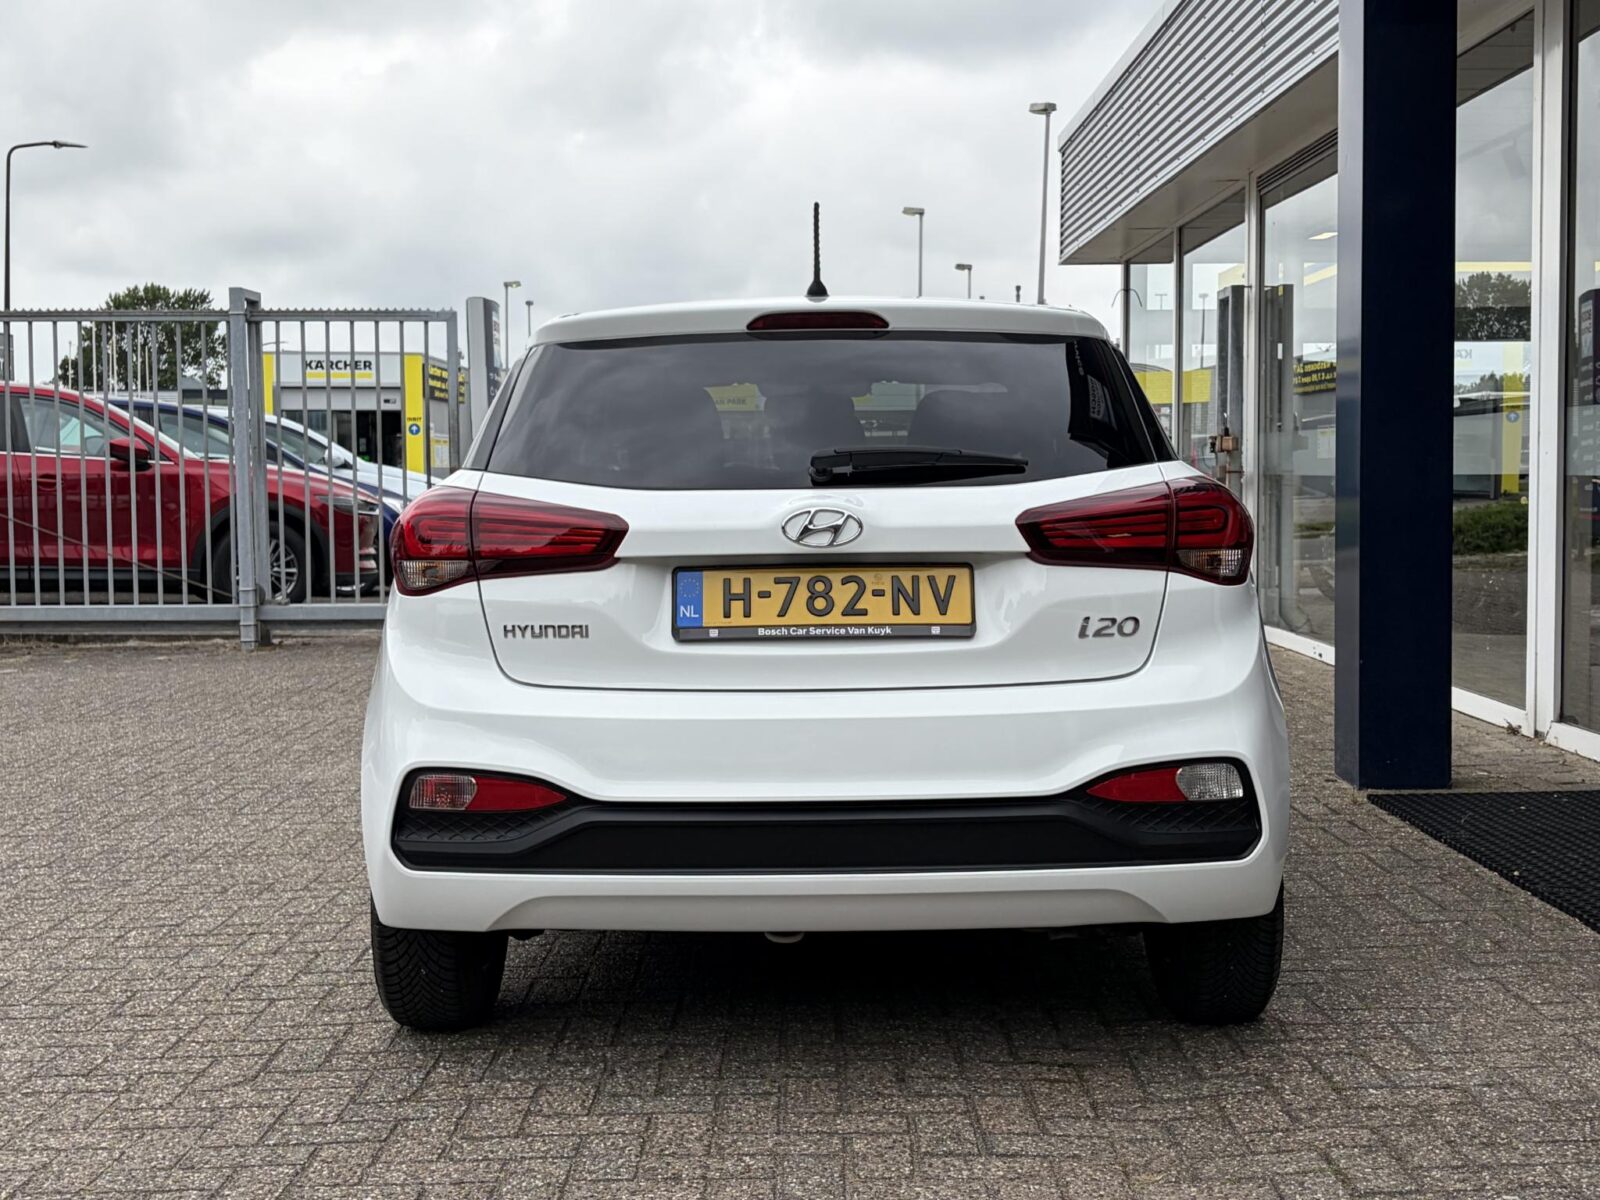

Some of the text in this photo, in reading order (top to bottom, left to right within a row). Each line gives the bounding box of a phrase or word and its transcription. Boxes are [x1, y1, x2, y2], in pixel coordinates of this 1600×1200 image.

[722, 575, 956, 618] H-782-NV
[679, 605, 699, 618] NL
[503, 624, 589, 639] HYUNDAI
[758, 626, 892, 636] Bosch Car Service Van Kuyk
[1078, 616, 1140, 639] i20
